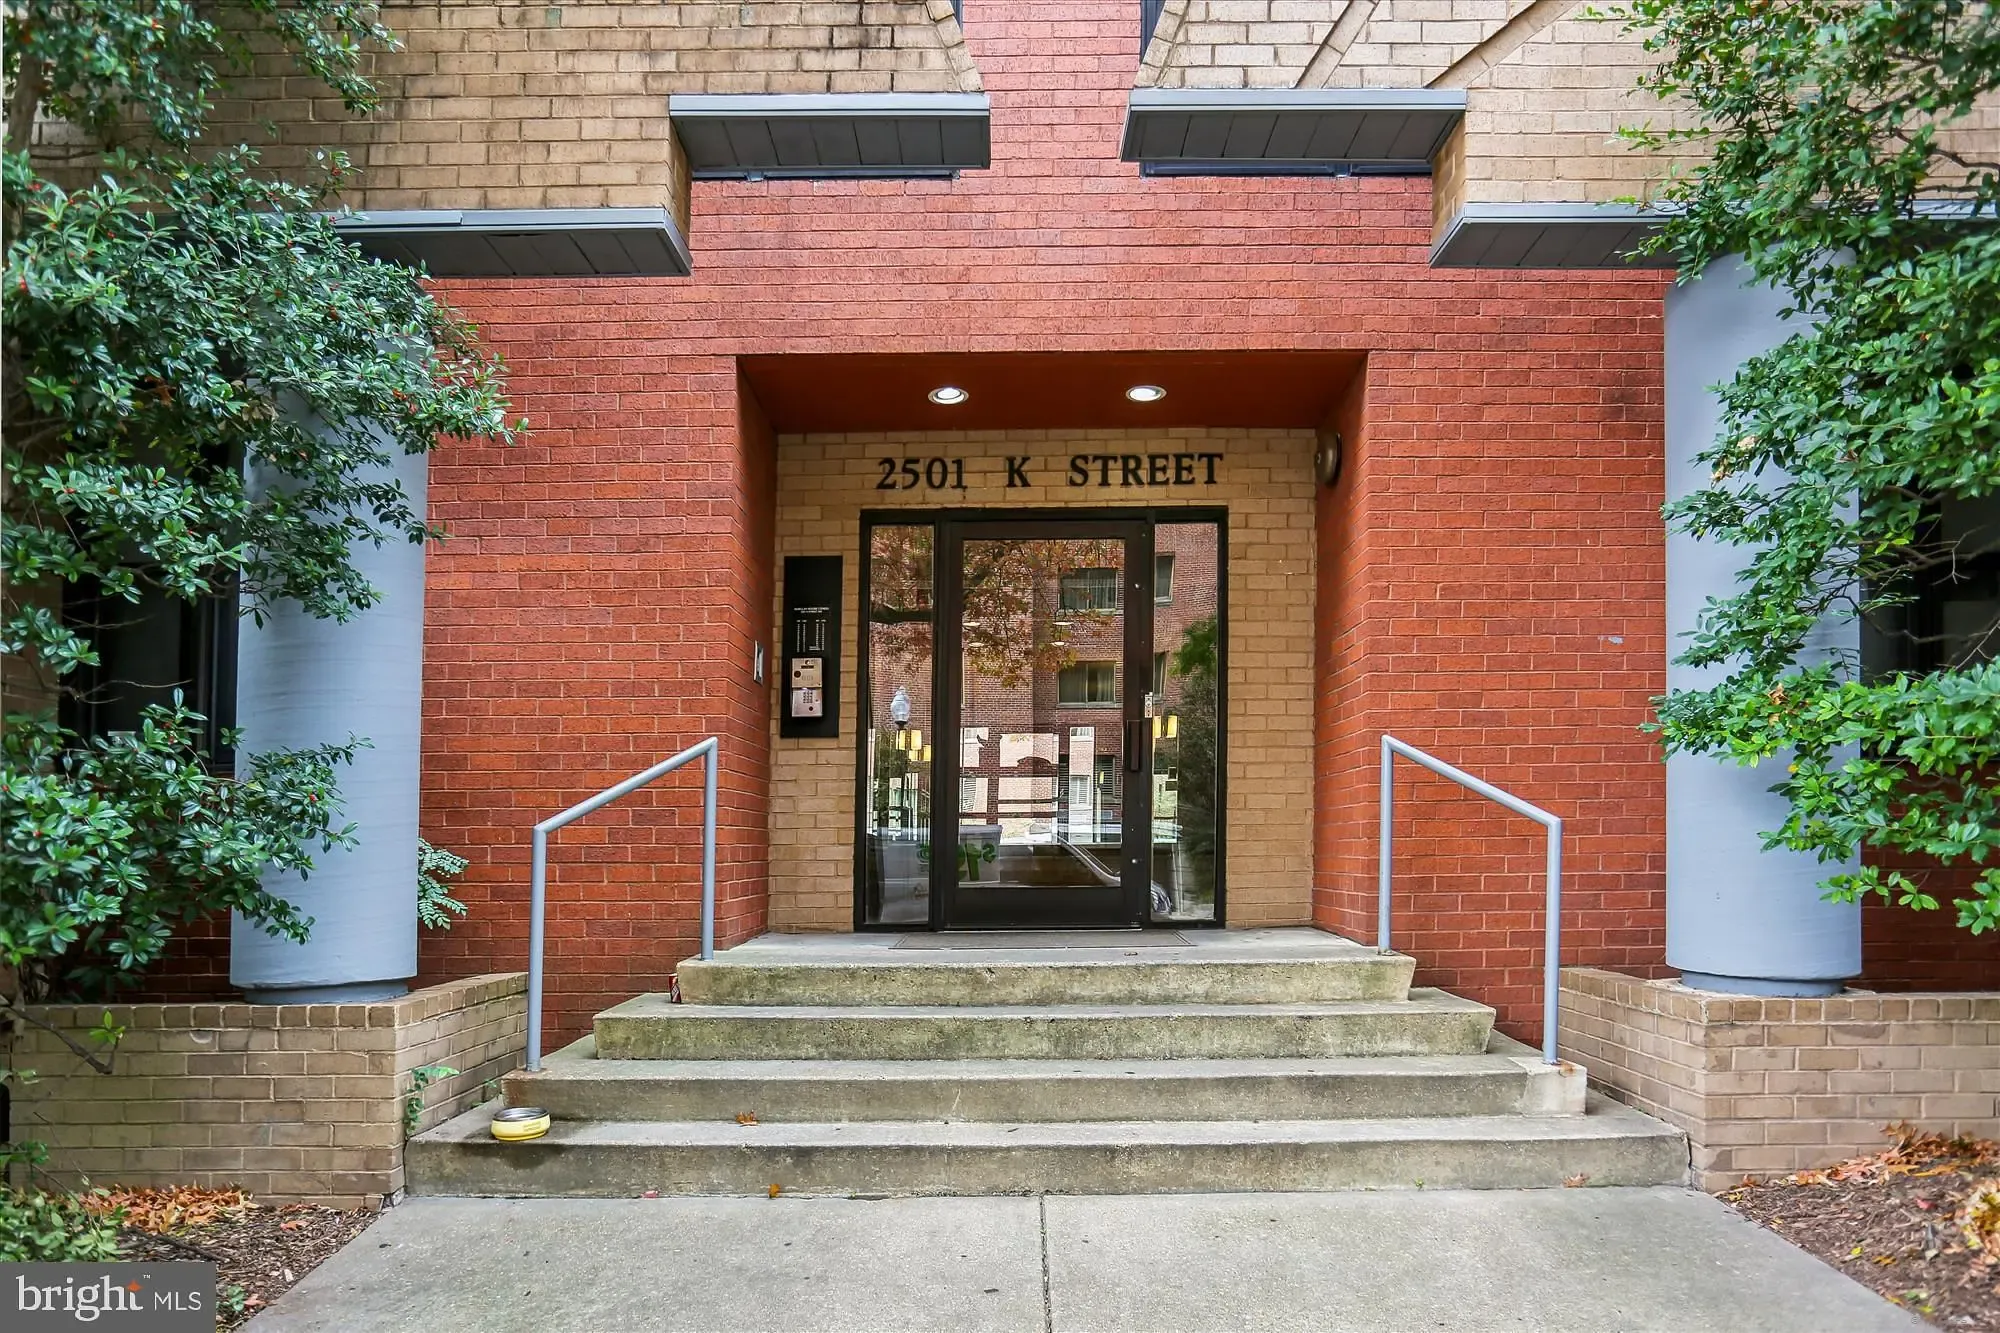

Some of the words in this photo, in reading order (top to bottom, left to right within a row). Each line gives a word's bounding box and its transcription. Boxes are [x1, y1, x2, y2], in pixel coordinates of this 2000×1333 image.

[876, 457, 968, 489] 2501
[1005, 456, 1031, 488] K
[1069, 453, 1224, 487] STREET
